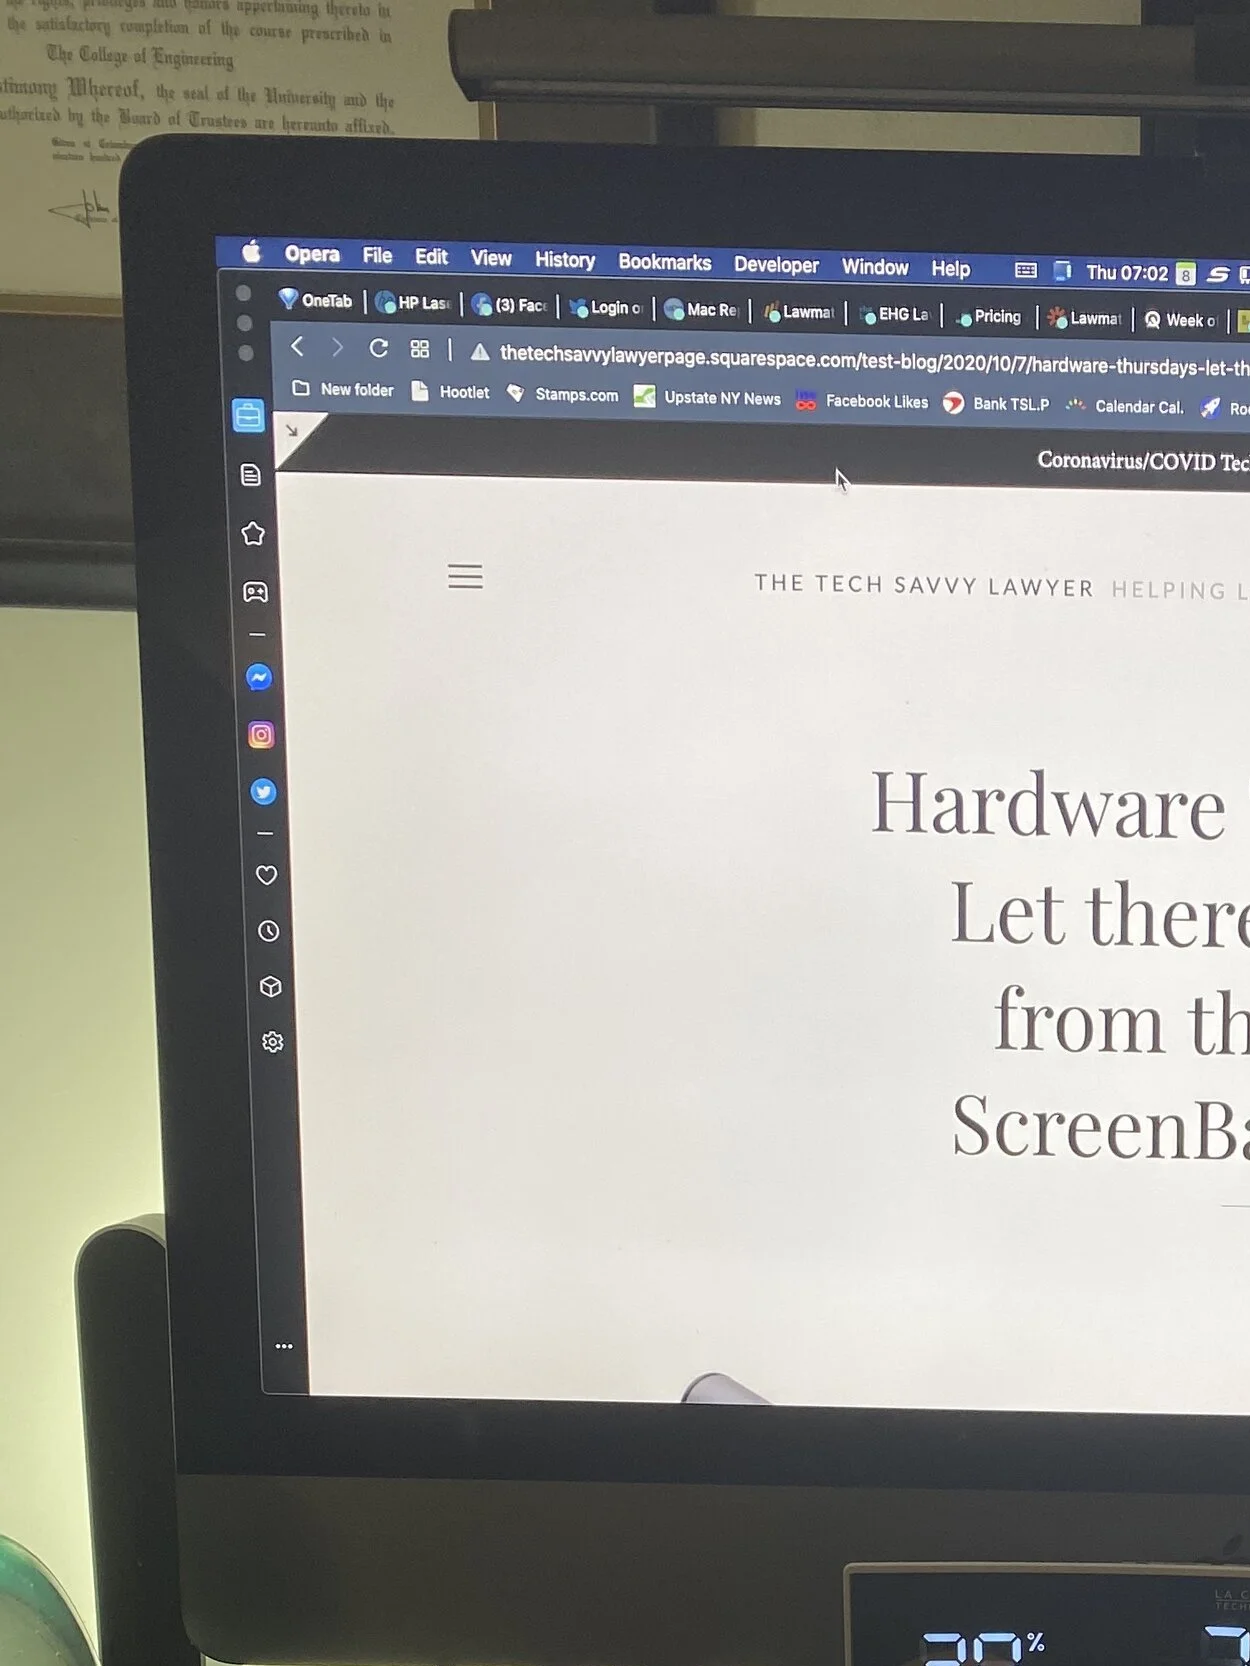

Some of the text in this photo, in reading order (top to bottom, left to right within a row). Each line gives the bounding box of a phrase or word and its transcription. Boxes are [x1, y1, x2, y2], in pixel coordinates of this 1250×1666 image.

[35, 15, 111, 36] satisfactory
[250, 24, 292, 38] course
[301, 27, 370, 44] prescribed
[47, 43, 234, 72] The College of Engineering
[263, 86, 337, 112] University
[343, 92, 367, 108] and
[285, 245, 971, 280] Opera File Edit View History Bookmarks Developer Window Help
[1087, 264, 1117, 281] Thu
[1121, 264, 1169, 282] 07:02
[302, 293, 353, 309] OneTab
[399, 296, 420, 310] HP
[496, 297, 515, 314] (3)
[592, 301, 629, 317] Login
[688, 303, 716, 318] Mac
[879, 307, 910, 322] EHG
[975, 309, 1022, 326] Pricing
[1166, 312, 1204, 328] Week
[321, 382, 395, 398] New folder
[440, 385, 490, 400] Hootlet
[536, 387, 619, 404] Stamps.com
[665, 390, 782, 408] Upstate NY News
[826, 394, 929, 410] Facebook Likes
[974, 397, 1007, 412] Bank
[1095, 399, 1185, 415] Calendar Cal.
[1037, 449, 1217, 473] Coronavirus/COVID
[754, 573, 804, 592] THE
[815, 574, 883, 594] TECH
[893, 576, 977, 595] SAVVY
[988, 577, 1093, 598] LAWYER
[1111, 580, 1226, 601] HELPING
[870, 768, 1226, 841] Hardware
[950, 880, 1066, 947] Let
[993, 983, 1163, 1055] from
[1215, 1589, 1233, 1599] LA
